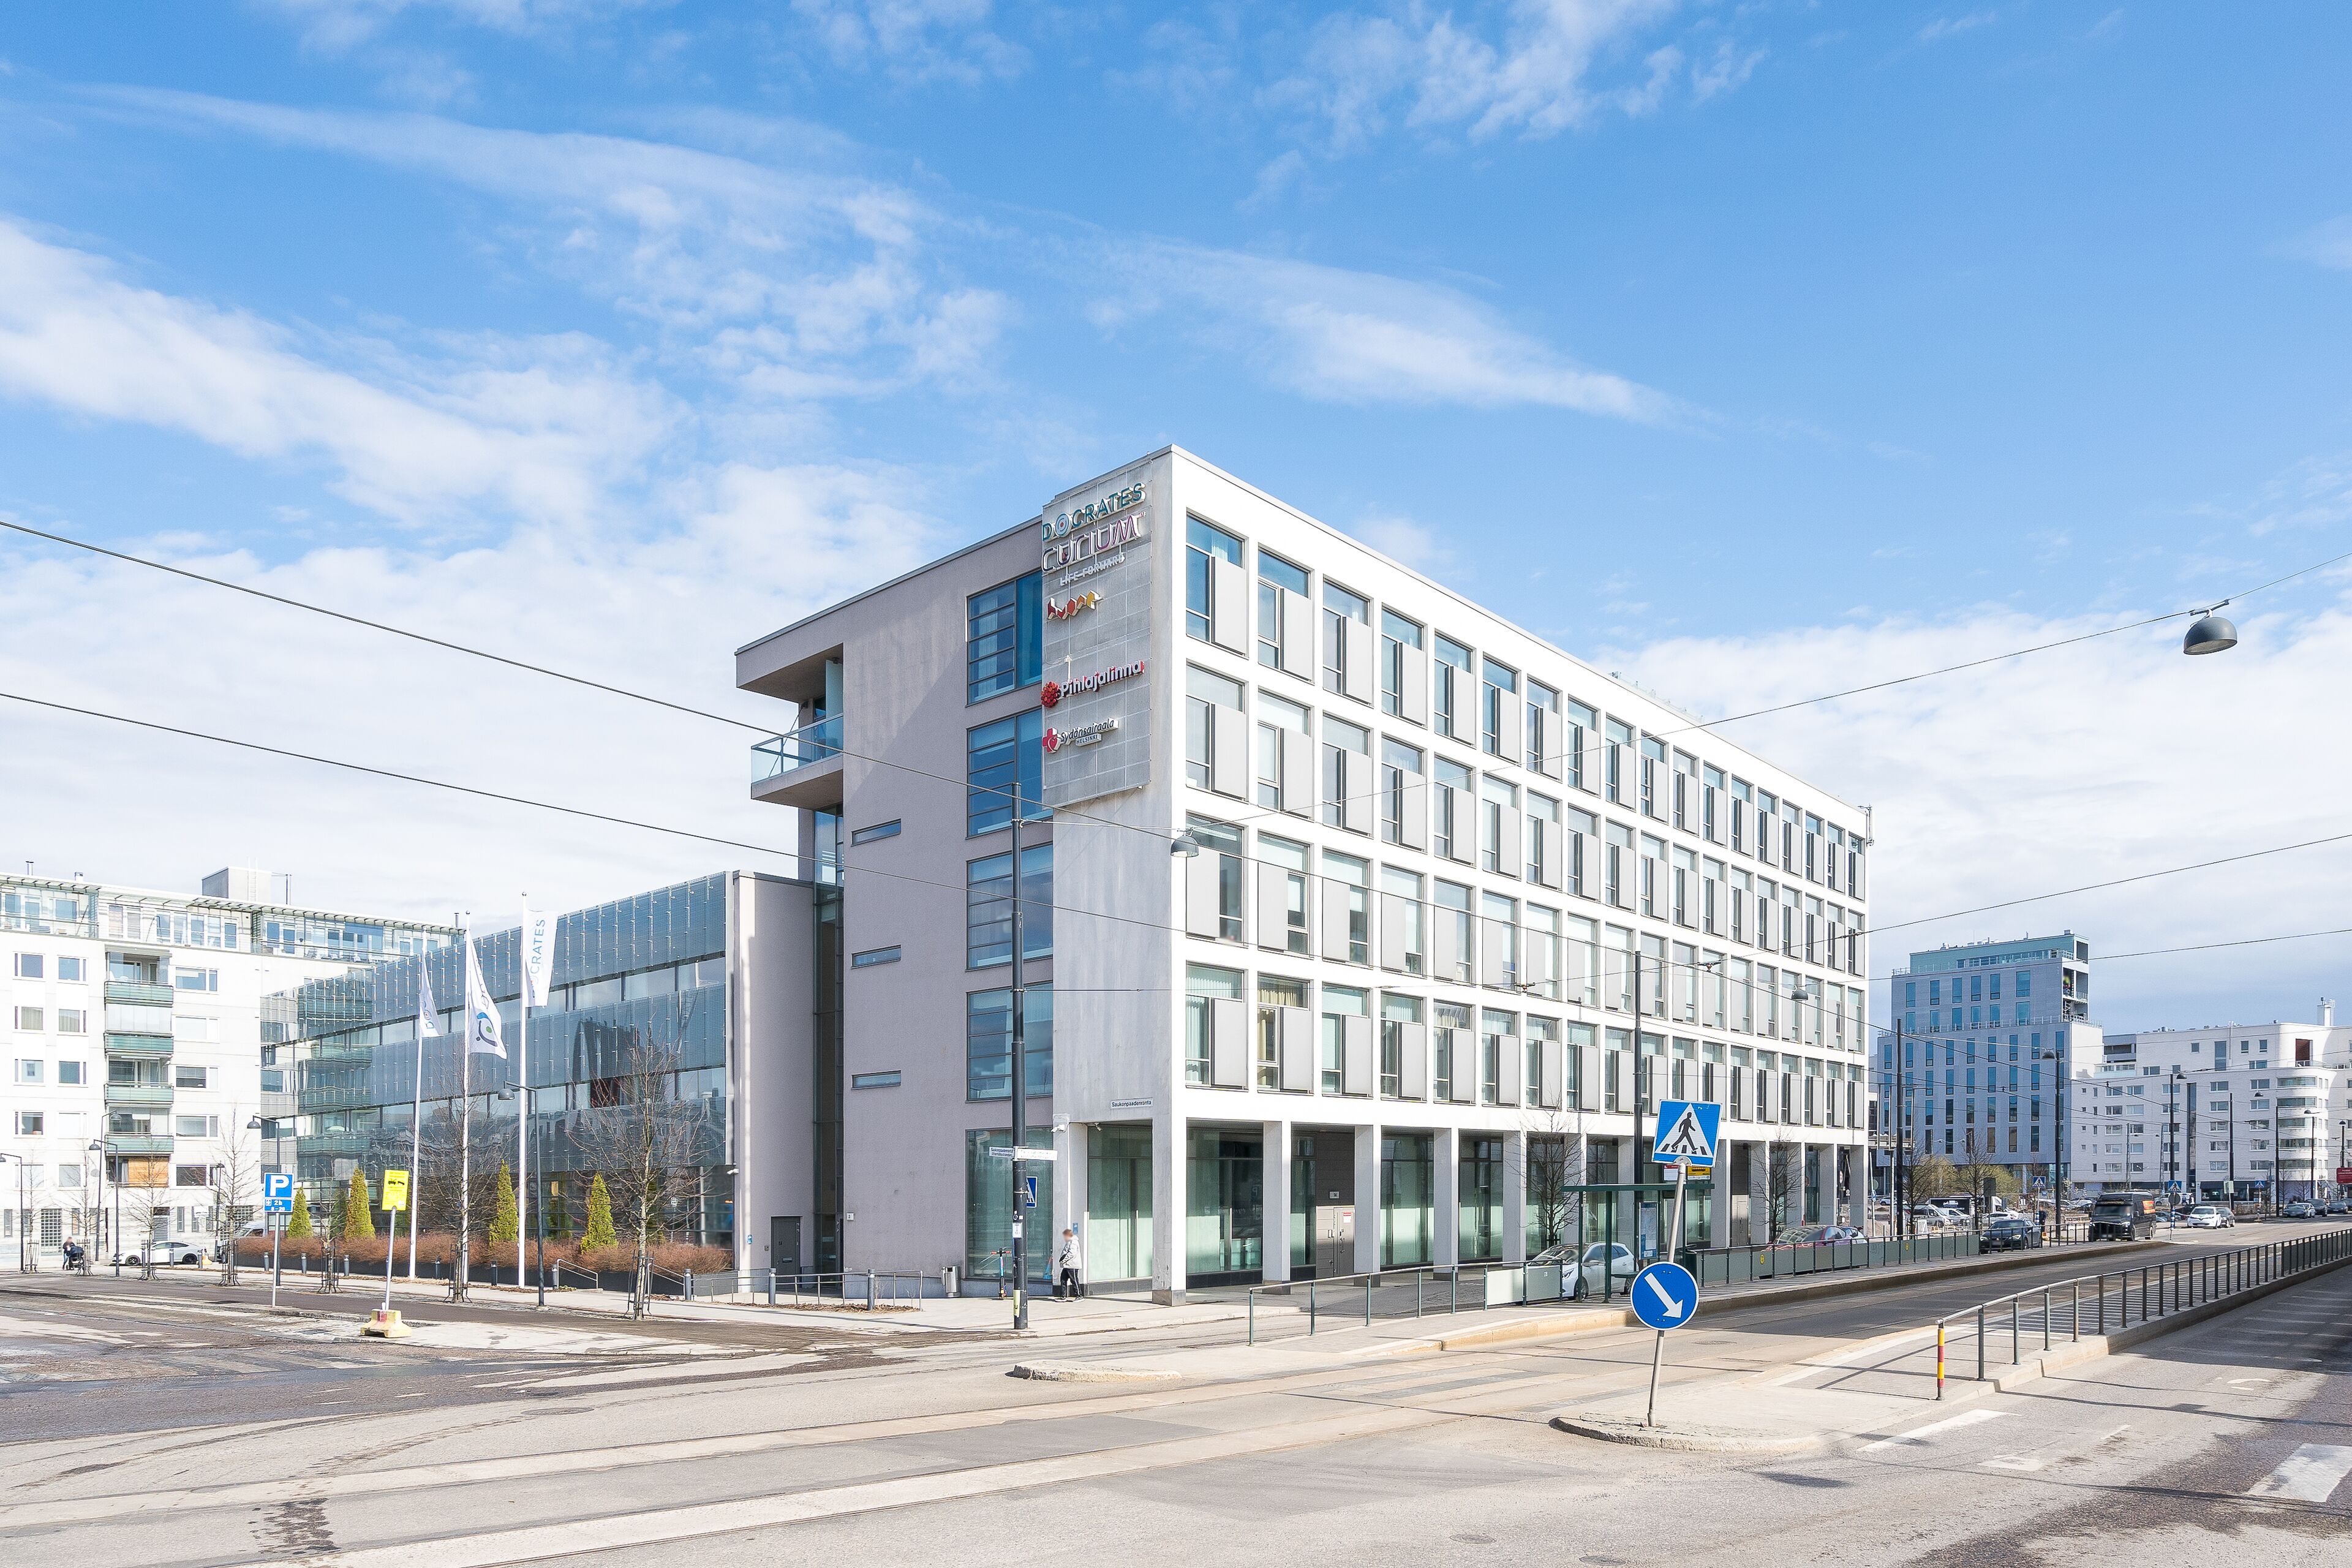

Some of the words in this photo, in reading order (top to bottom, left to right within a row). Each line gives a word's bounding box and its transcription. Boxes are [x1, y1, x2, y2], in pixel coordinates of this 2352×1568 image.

[1042, 483, 1145, 541] DOCRATES
[1061, 660, 1144, 697] Pihlajalinna
[1061, 718, 1115, 743] Sydänsairaala
[1076, 734, 1098, 745] HELSINKI
[270, 1175, 290, 1196] P
